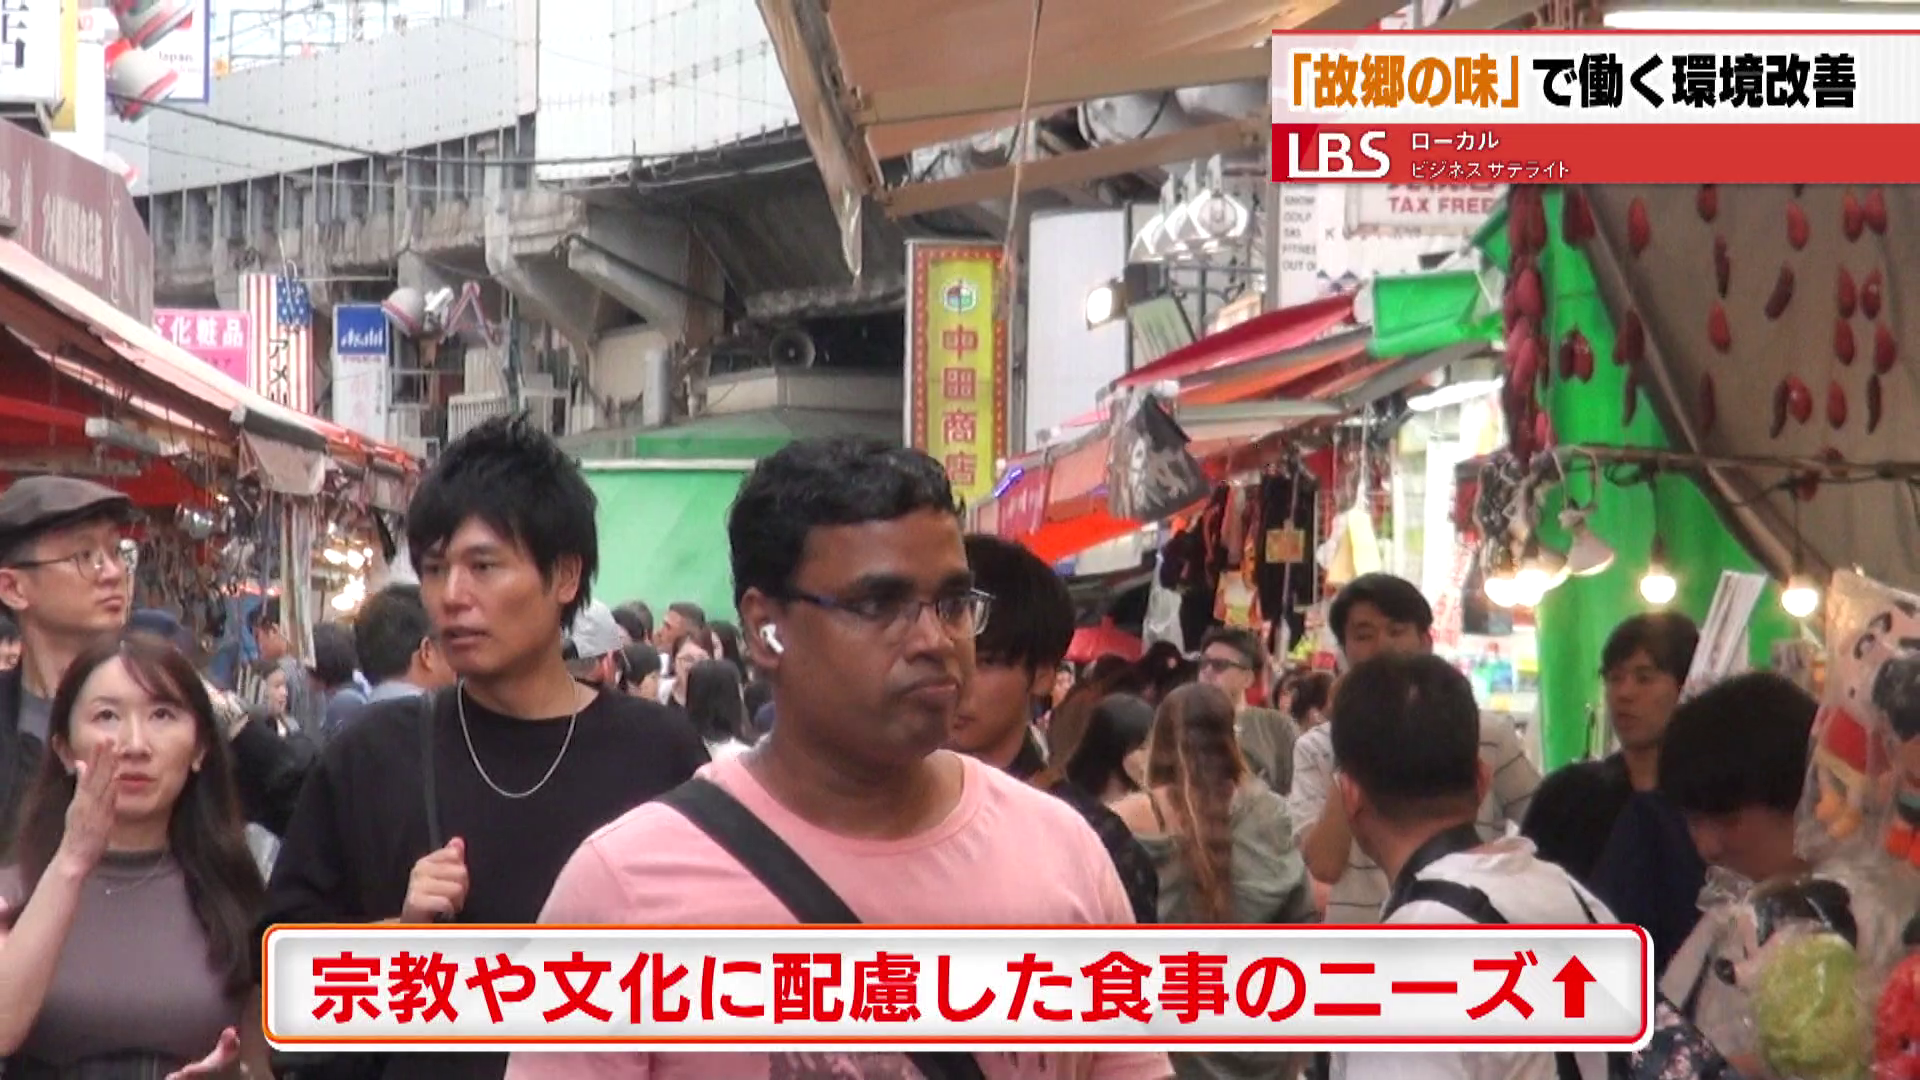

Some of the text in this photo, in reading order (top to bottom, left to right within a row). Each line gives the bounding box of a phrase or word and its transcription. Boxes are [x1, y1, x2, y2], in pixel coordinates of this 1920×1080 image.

[1389, 197, 1495, 214] TAX FREE
[340, 327, 383, 348] Asahi
[942, 323, 978, 486] 中田商店
